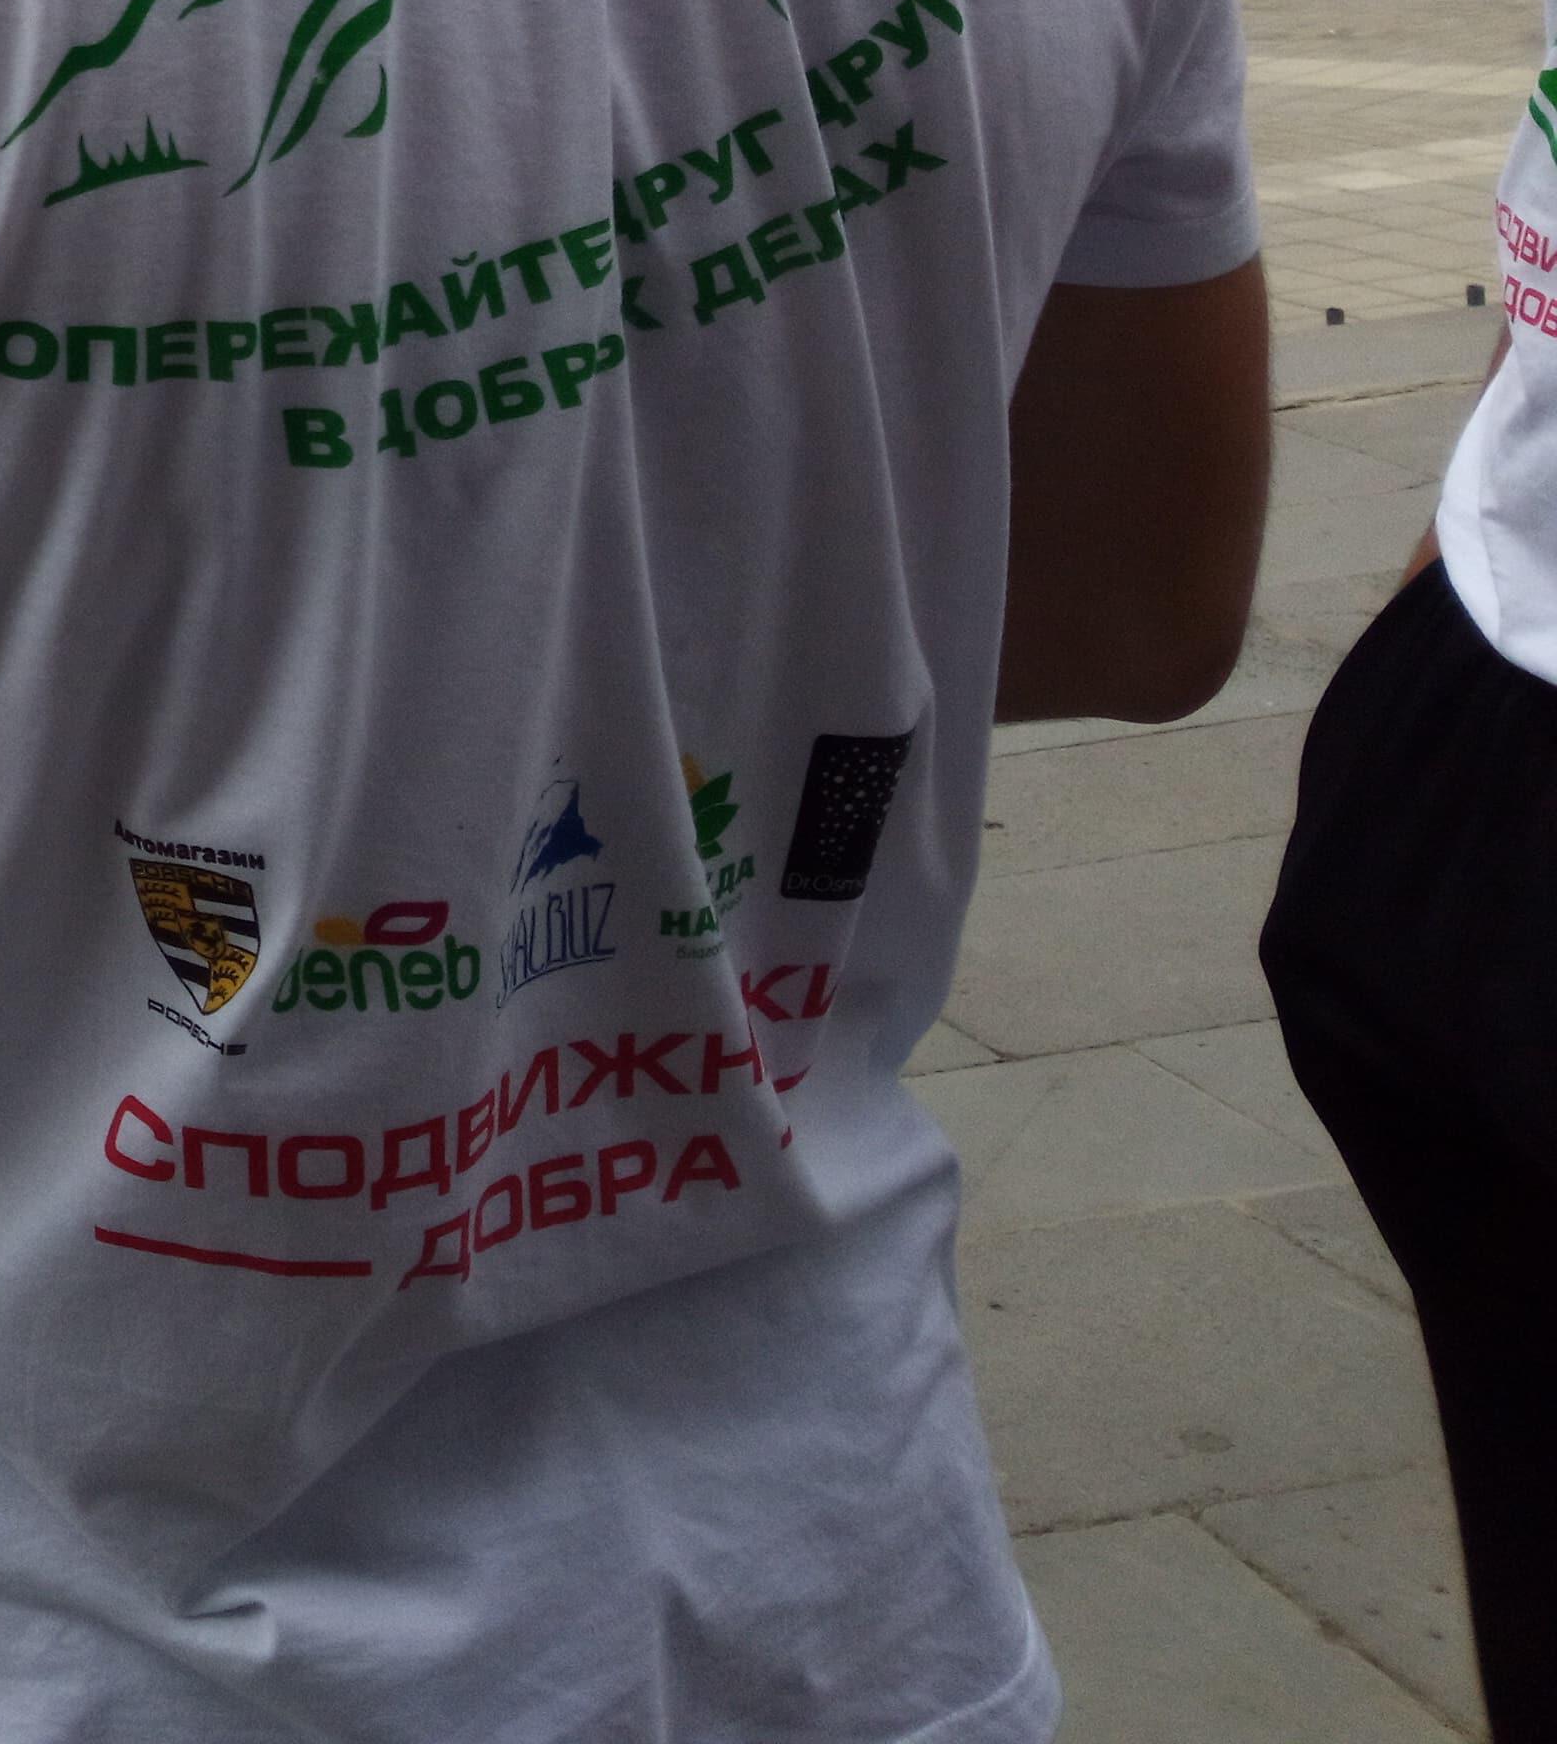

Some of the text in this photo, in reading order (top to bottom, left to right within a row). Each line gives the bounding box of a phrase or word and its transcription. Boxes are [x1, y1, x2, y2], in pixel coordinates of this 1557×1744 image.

[283, 404, 354, 469] В
[661, 855, 756, 937] НАДА
[397, 1134, 742, 1290] ДОБРА
